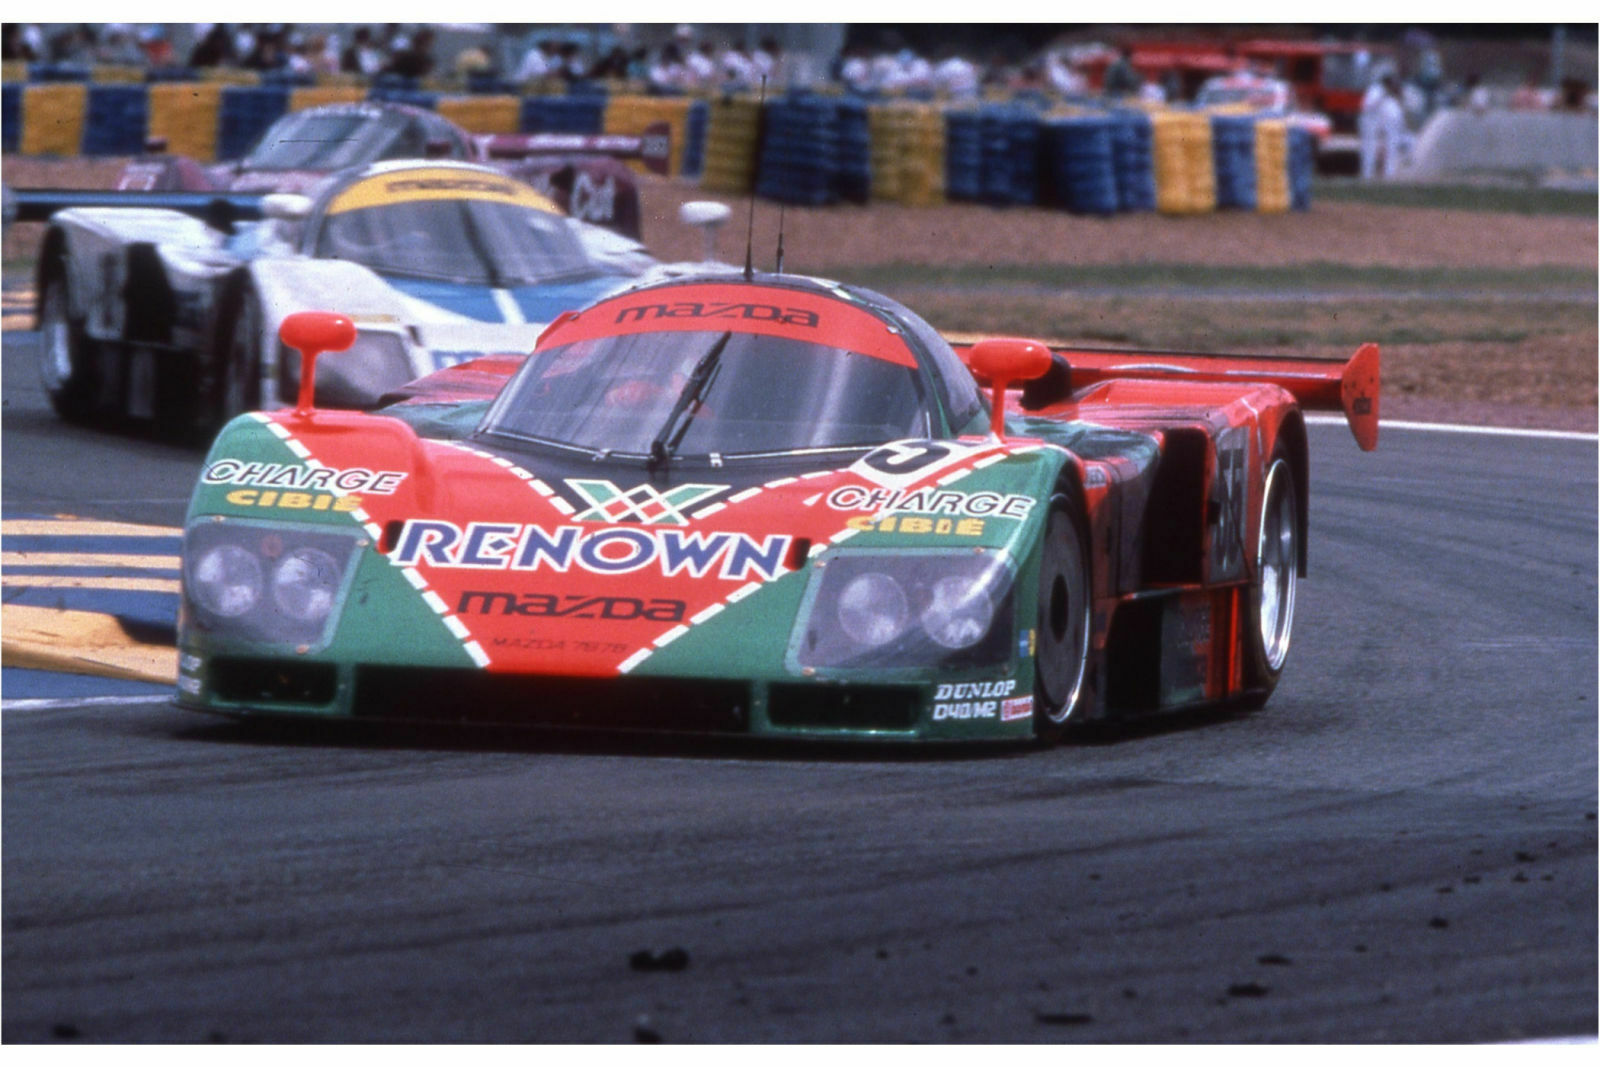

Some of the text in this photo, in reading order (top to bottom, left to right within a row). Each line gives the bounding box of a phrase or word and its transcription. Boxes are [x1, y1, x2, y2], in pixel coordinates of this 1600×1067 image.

[203, 460, 408, 494] CHARGE
[828, 486, 1036, 520] CHARGE
[390, 519, 792, 581] RENOWN
[933, 680, 1016, 700] DUNLOP
